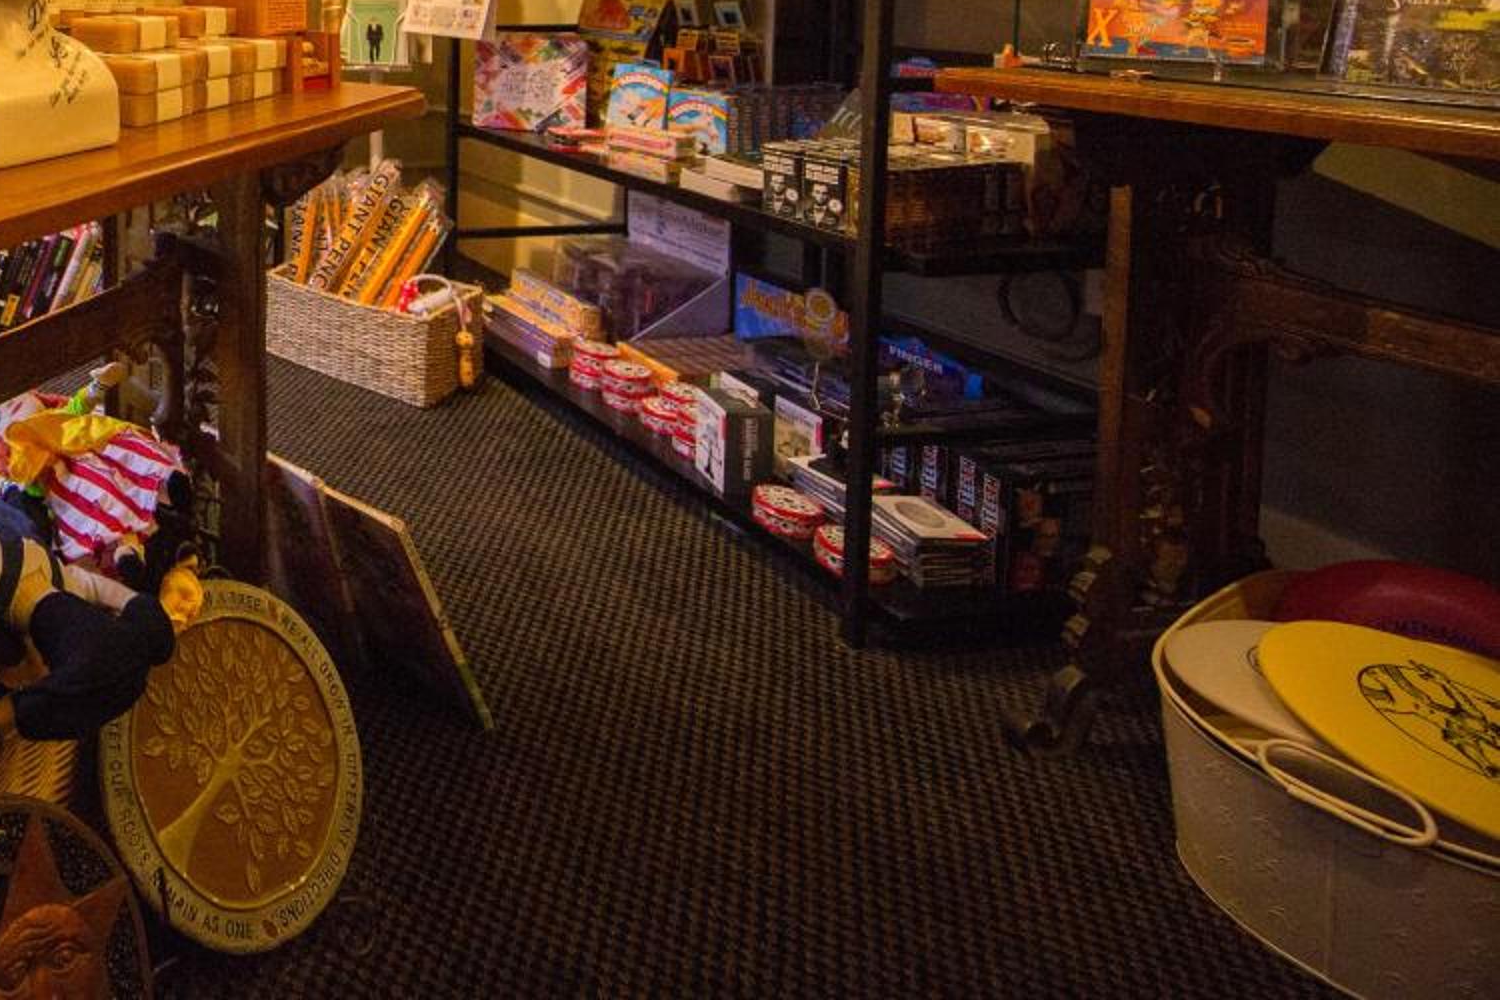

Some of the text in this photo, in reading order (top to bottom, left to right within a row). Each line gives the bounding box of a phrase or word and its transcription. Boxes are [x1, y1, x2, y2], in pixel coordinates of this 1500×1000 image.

[347, 174, 389, 236] GIANT
[202, 913, 220, 935] AS
[225, 918, 253, 940] ONE
